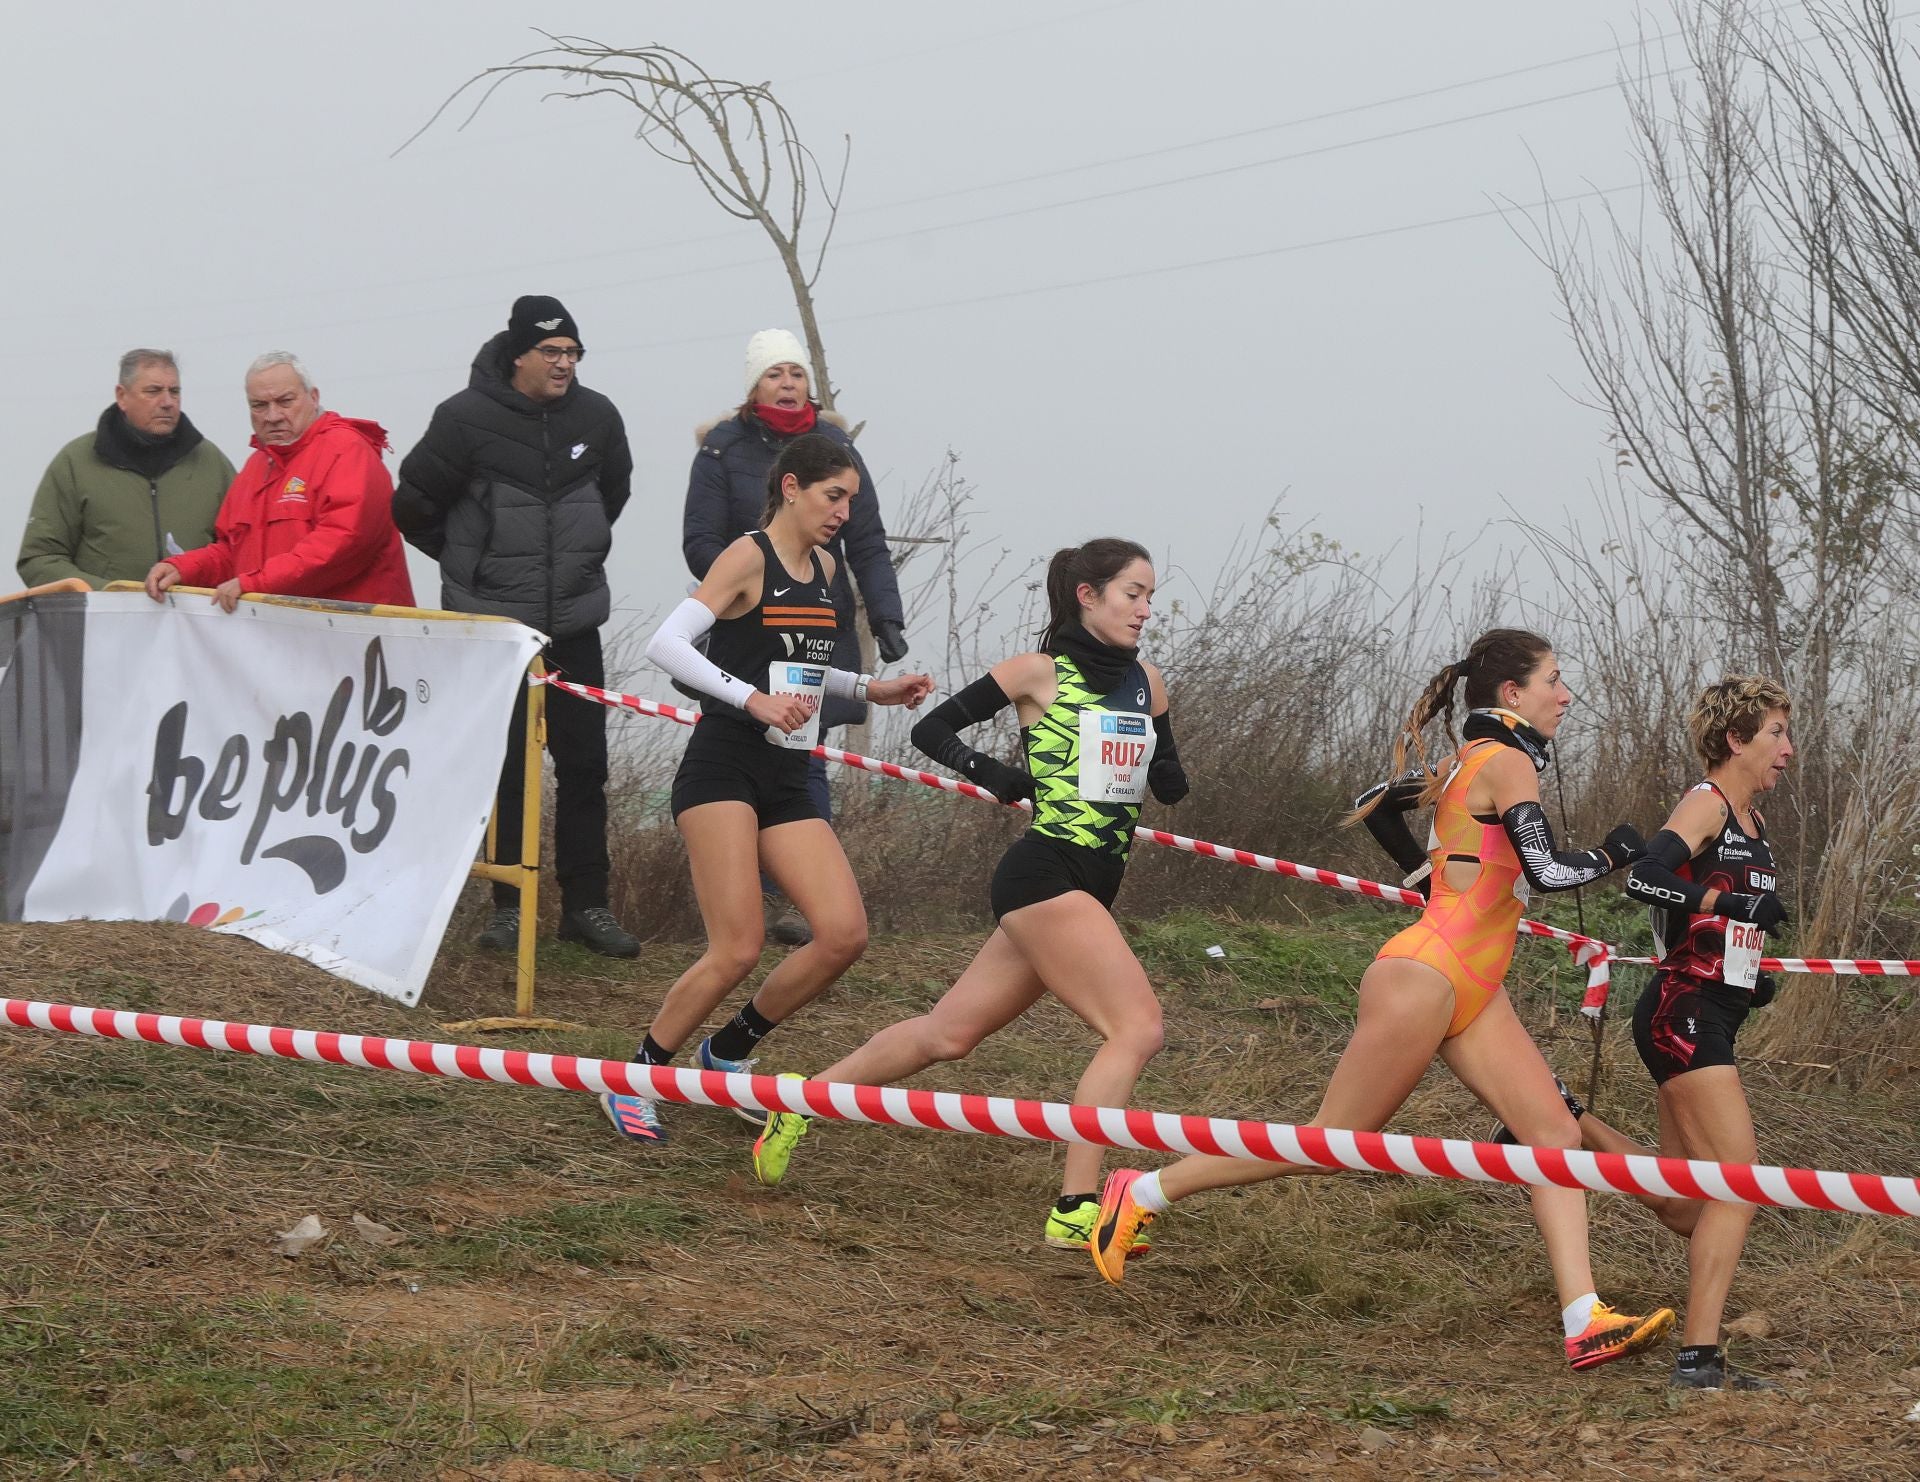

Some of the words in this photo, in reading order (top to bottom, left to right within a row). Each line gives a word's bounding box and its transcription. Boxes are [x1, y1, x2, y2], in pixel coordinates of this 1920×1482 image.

[806, 638, 835, 652] VICKY
[1101, 740, 1146, 767] RUIZ
[1114, 773, 1131, 783] 1003
[1574, 1324, 1635, 1354] NITRO
